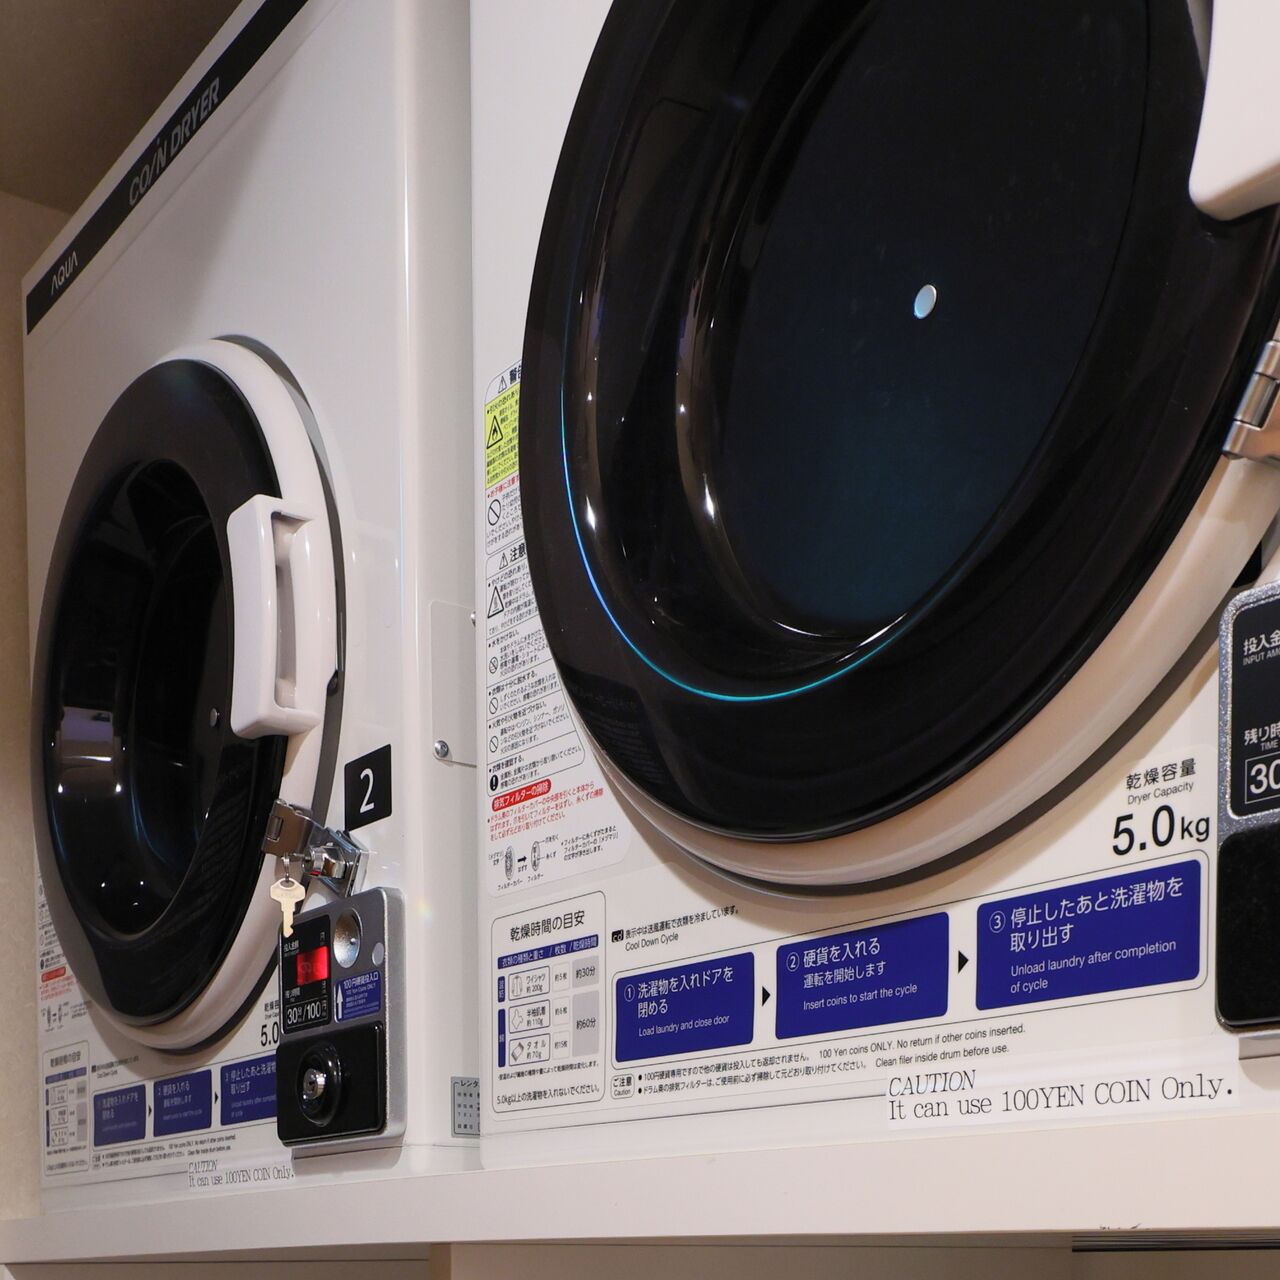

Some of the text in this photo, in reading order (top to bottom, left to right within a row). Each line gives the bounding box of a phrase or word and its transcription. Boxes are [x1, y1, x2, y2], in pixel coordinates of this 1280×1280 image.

[170, 77, 220, 157] DRYER
[51, 251, 78, 296] AQUA
[1243, 651, 1265, 666] INPUT
[1260, 739, 1279, 751] TIME
[1126, 757, 1197, 791] 乾燥容量
[359, 768, 375, 815] 2
[1127, 780, 1194, 806] Dryer Capacity
[1011, 876, 1183, 930] 停止したあと洗濯物を
[510, 911, 585, 942] 乾燥時間の目安
[1010, 923, 1074, 953] 取り出す
[625, 932, 679, 951] Cool Down Cycle
[803, 937, 880, 969] 硬貨を入れる
[1011, 939, 1177, 977] Unload laundry after completion
[576, 966, 595, 979] 約30分
[637, 967, 734, 1000] 洗濯物を入れドアを
[803, 961, 886, 989] 運転を開始します
[1011, 977, 1048, 994] of cycle
[637, 1000, 668, 1019] 閉める
[804, 984, 917, 1011] Insert coins to start the cycle
[576, 1018, 596, 1030] 約60分
[638, 1014, 730, 1037] Load laundry and close door
[819, 1048, 832, 1059] 100
[834, 1047, 848, 1057] Yen
[849, 1045, 869, 1056] coins
[870, 1040, 895, 1053] ONLY.
[897, 1038, 908, 1049] No
[910, 1034, 933, 1048] return
[935, 1033, 941, 1045] if
[942, 1030, 963, 1044] other
[965, 1028, 987, 1041] coins
[989, 1024, 1026, 1039] inserted.
[612, 1077, 632, 1089] ご注意
[889, 1069, 977, 1097] CAUTION
[889, 1073, 1233, 1120] It can use 100YEN COIN Only.
